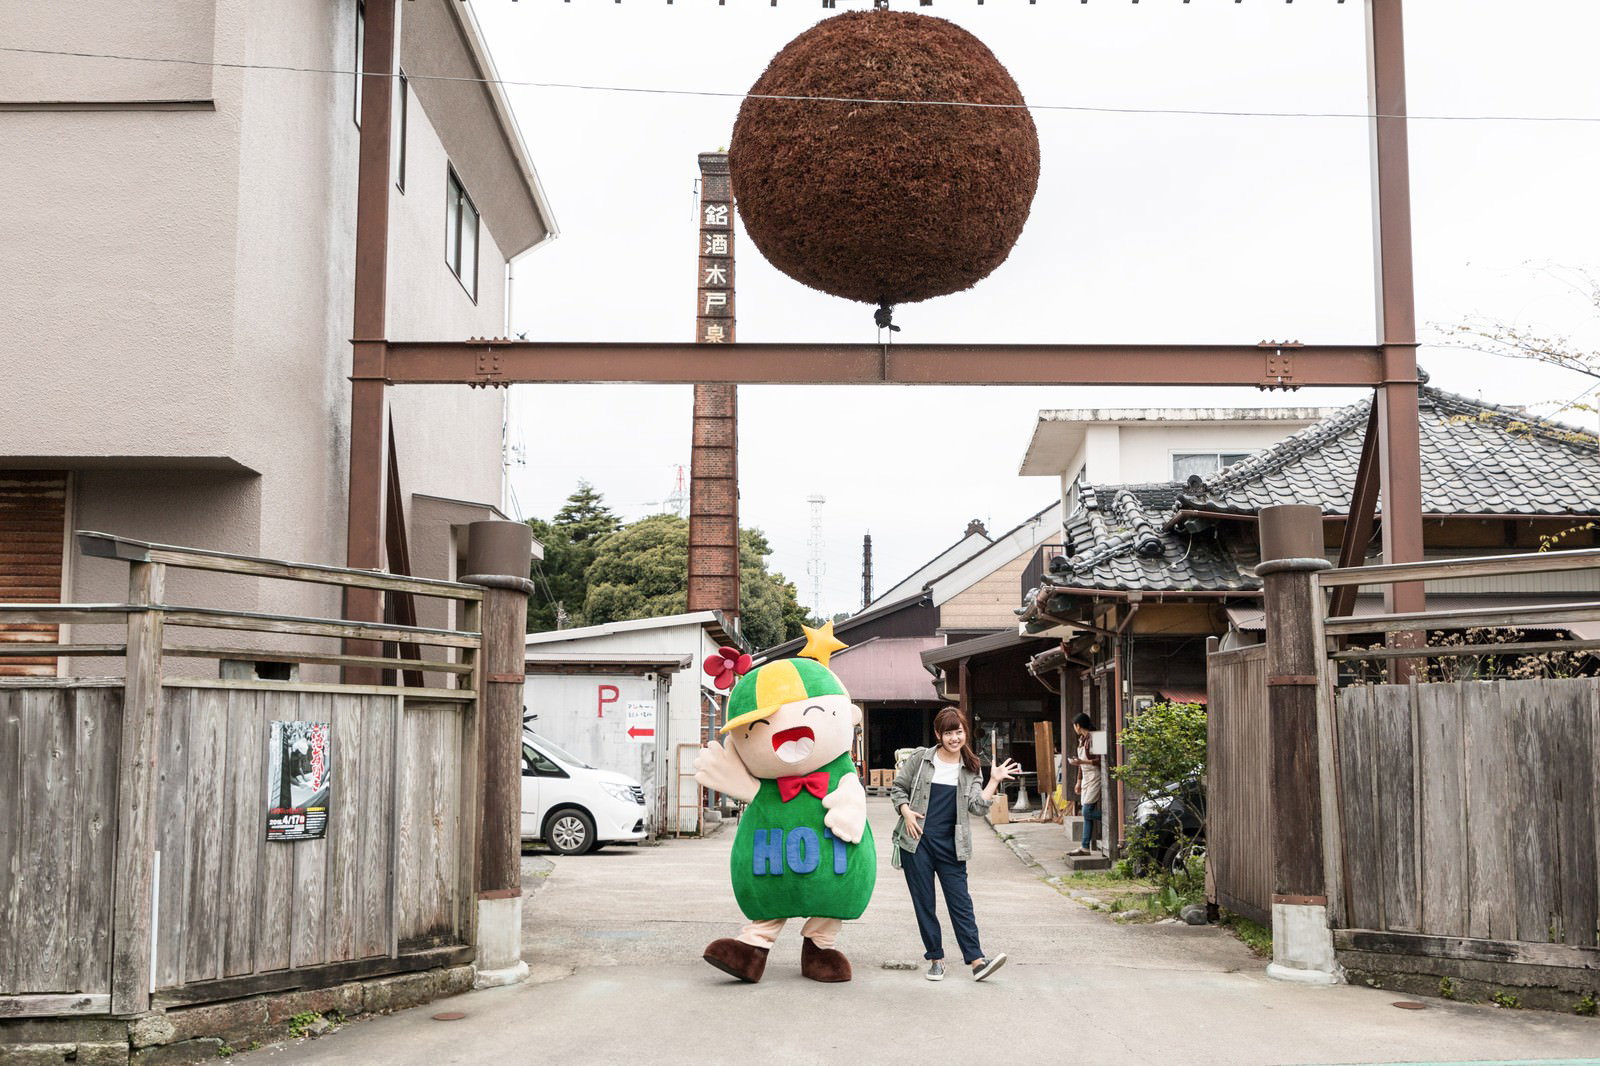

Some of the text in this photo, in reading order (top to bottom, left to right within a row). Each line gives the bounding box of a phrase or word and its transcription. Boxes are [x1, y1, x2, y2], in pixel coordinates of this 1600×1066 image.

[704, 204, 728, 343] 銘酒木戸泉
[598, 684, 620, 718] P
[753, 825, 847, 875] HOT
